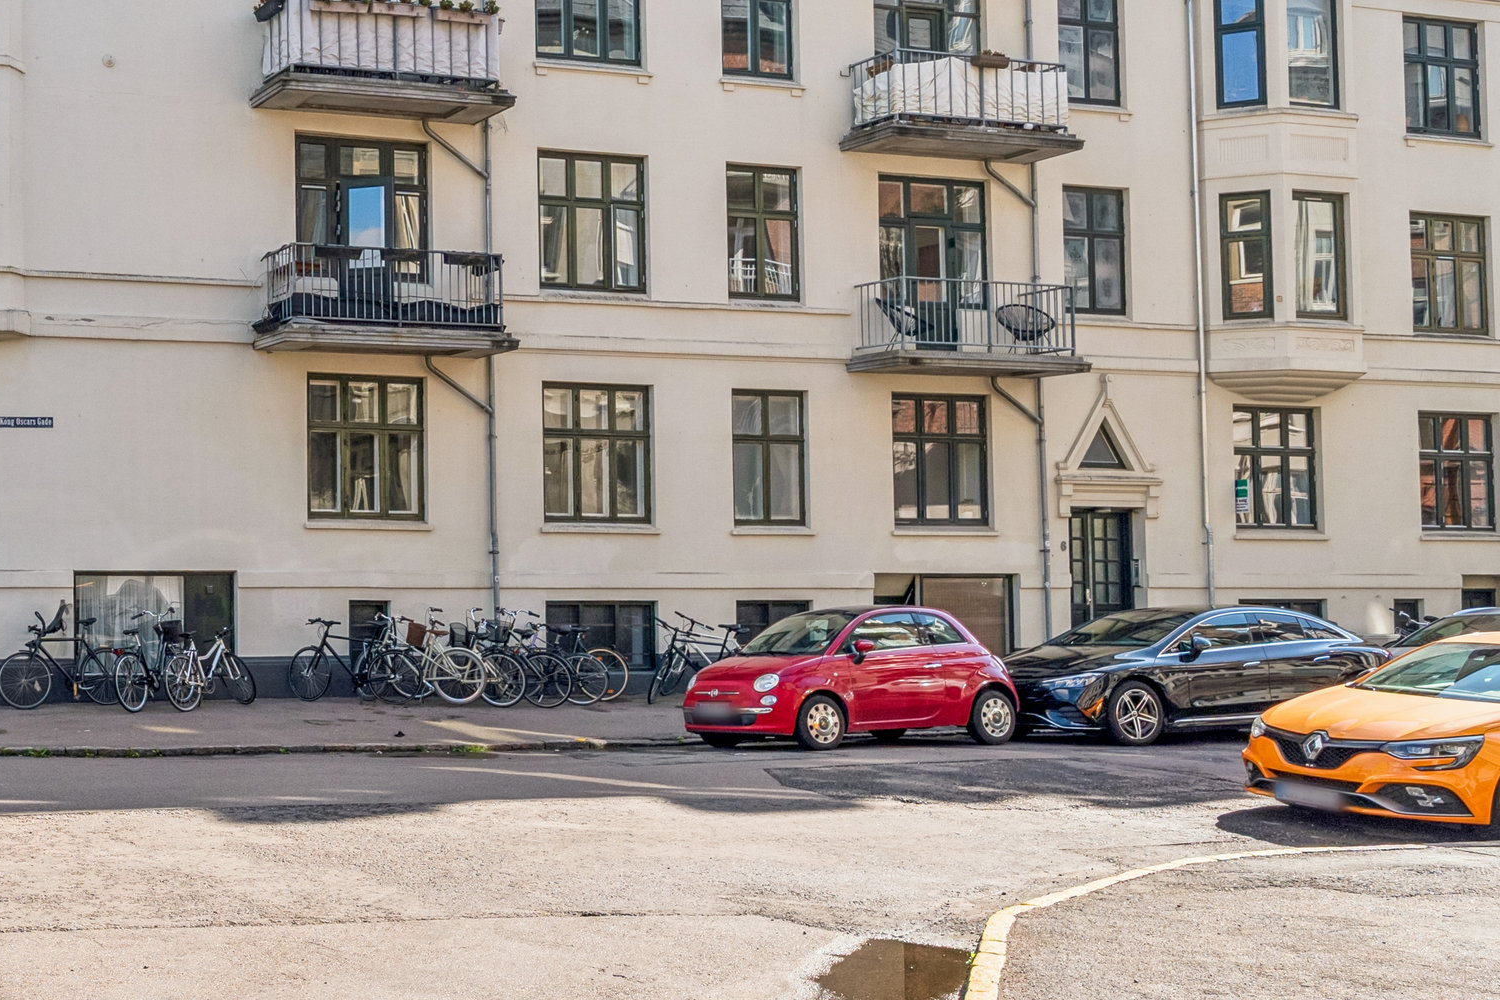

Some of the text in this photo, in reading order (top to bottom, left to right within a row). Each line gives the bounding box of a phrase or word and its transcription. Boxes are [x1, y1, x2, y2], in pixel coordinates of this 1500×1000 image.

[0, 417, 52, 427] Kong Oscars Gade
[1060, 541, 1067, 551] 6
